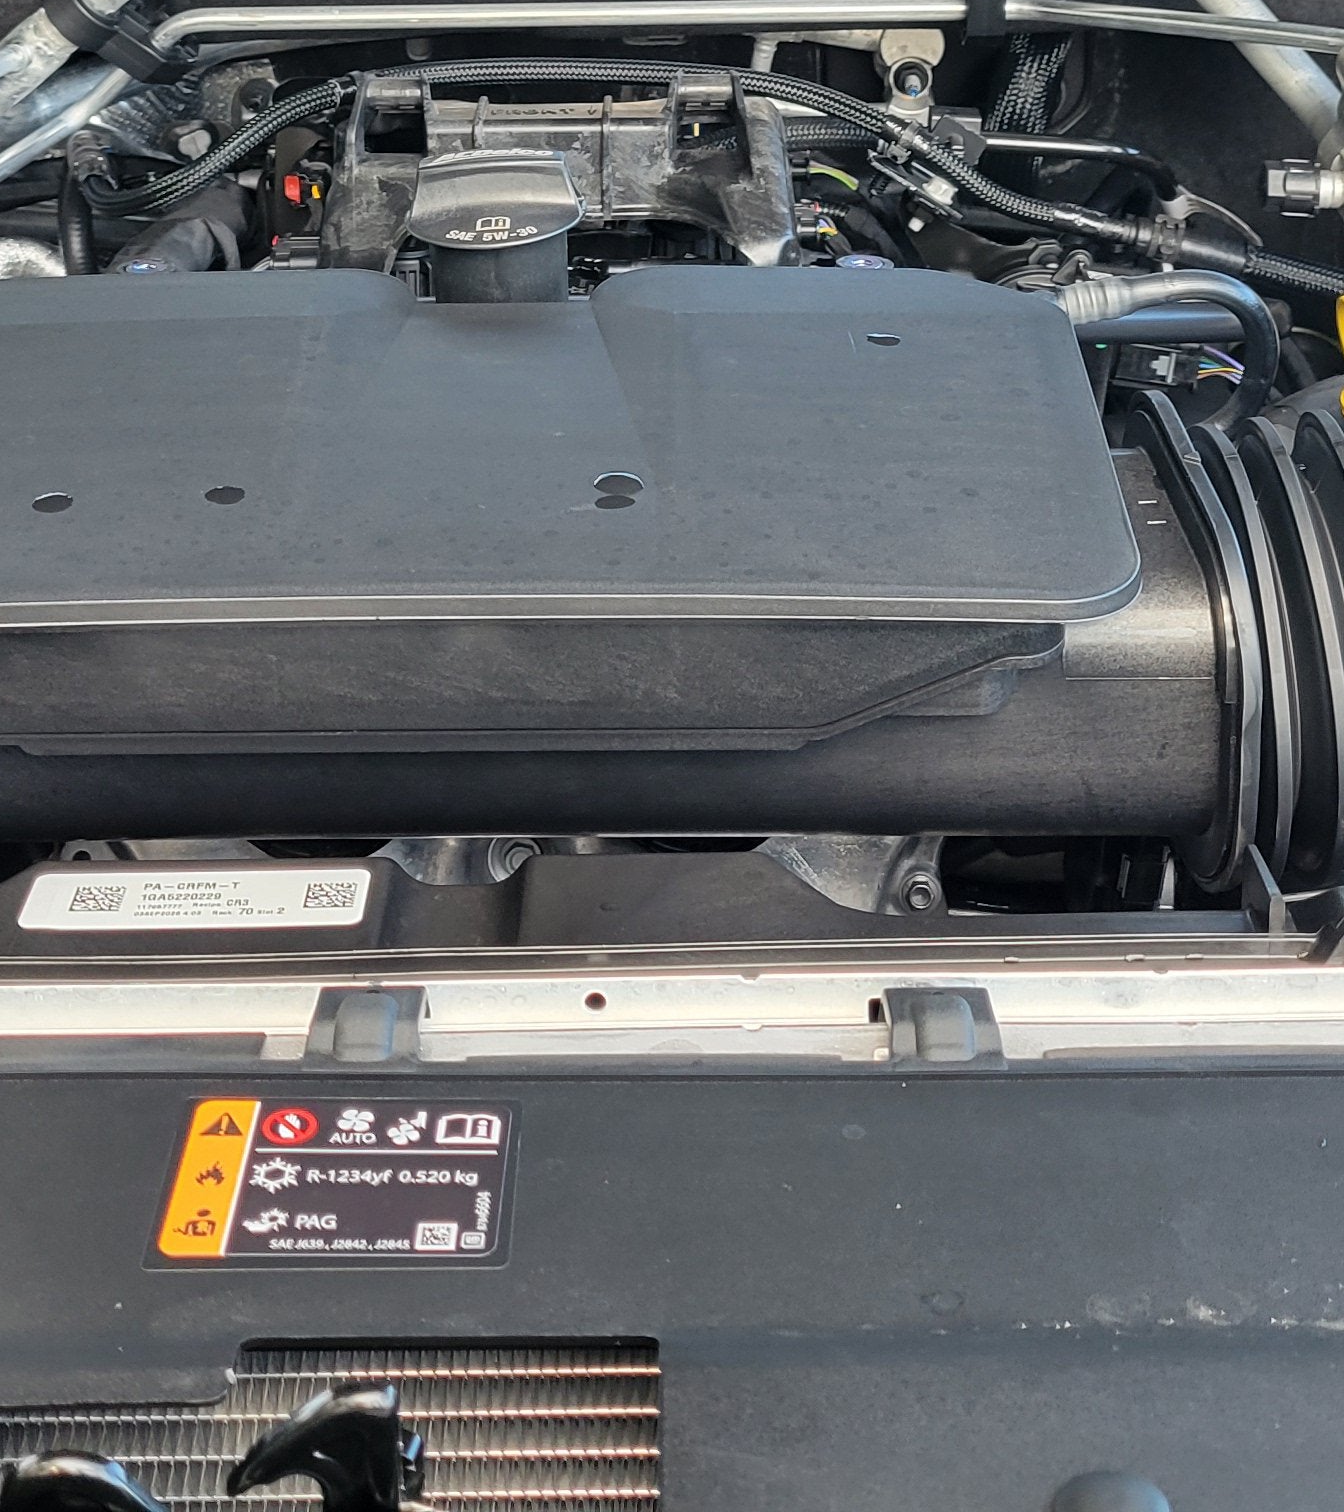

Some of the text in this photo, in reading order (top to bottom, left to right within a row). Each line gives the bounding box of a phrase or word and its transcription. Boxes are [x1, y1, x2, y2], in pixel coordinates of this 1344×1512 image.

[446, 226, 538, 242] SAE 5W-30
[238, 907, 254, 916] 70
[329, 1132, 377, 1145] AUTO
[306, 1169, 479, 1187] R-1234yf 0.520 kg
[294, 1214, 338, 1230] PAG
[268, 1238, 294, 1250] SAE
